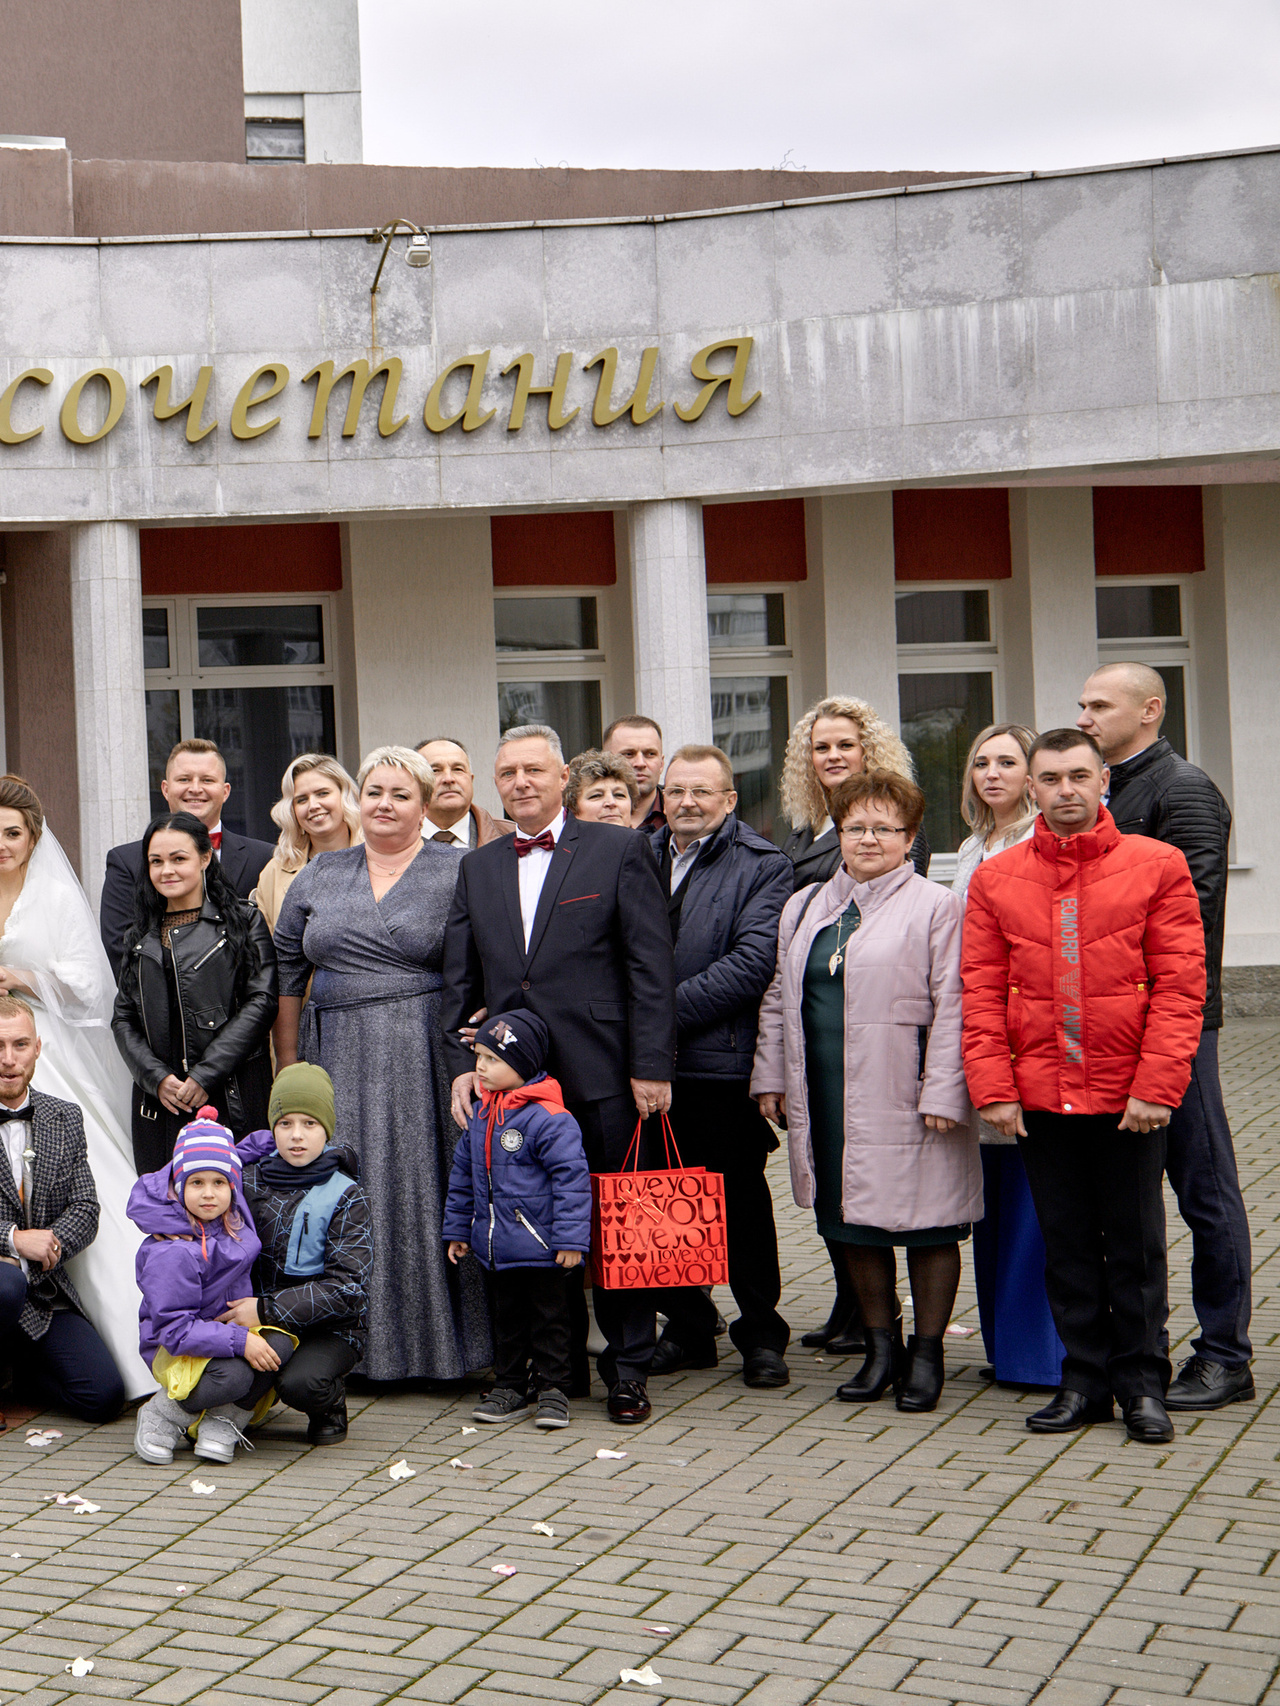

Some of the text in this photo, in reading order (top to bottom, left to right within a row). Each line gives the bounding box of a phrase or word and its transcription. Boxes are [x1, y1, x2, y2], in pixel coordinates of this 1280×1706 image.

[666, 1175, 723, 1198] you
[671, 1226, 726, 1249] you
[693, 1247, 727, 1262] you
[673, 1262, 728, 1285] you
